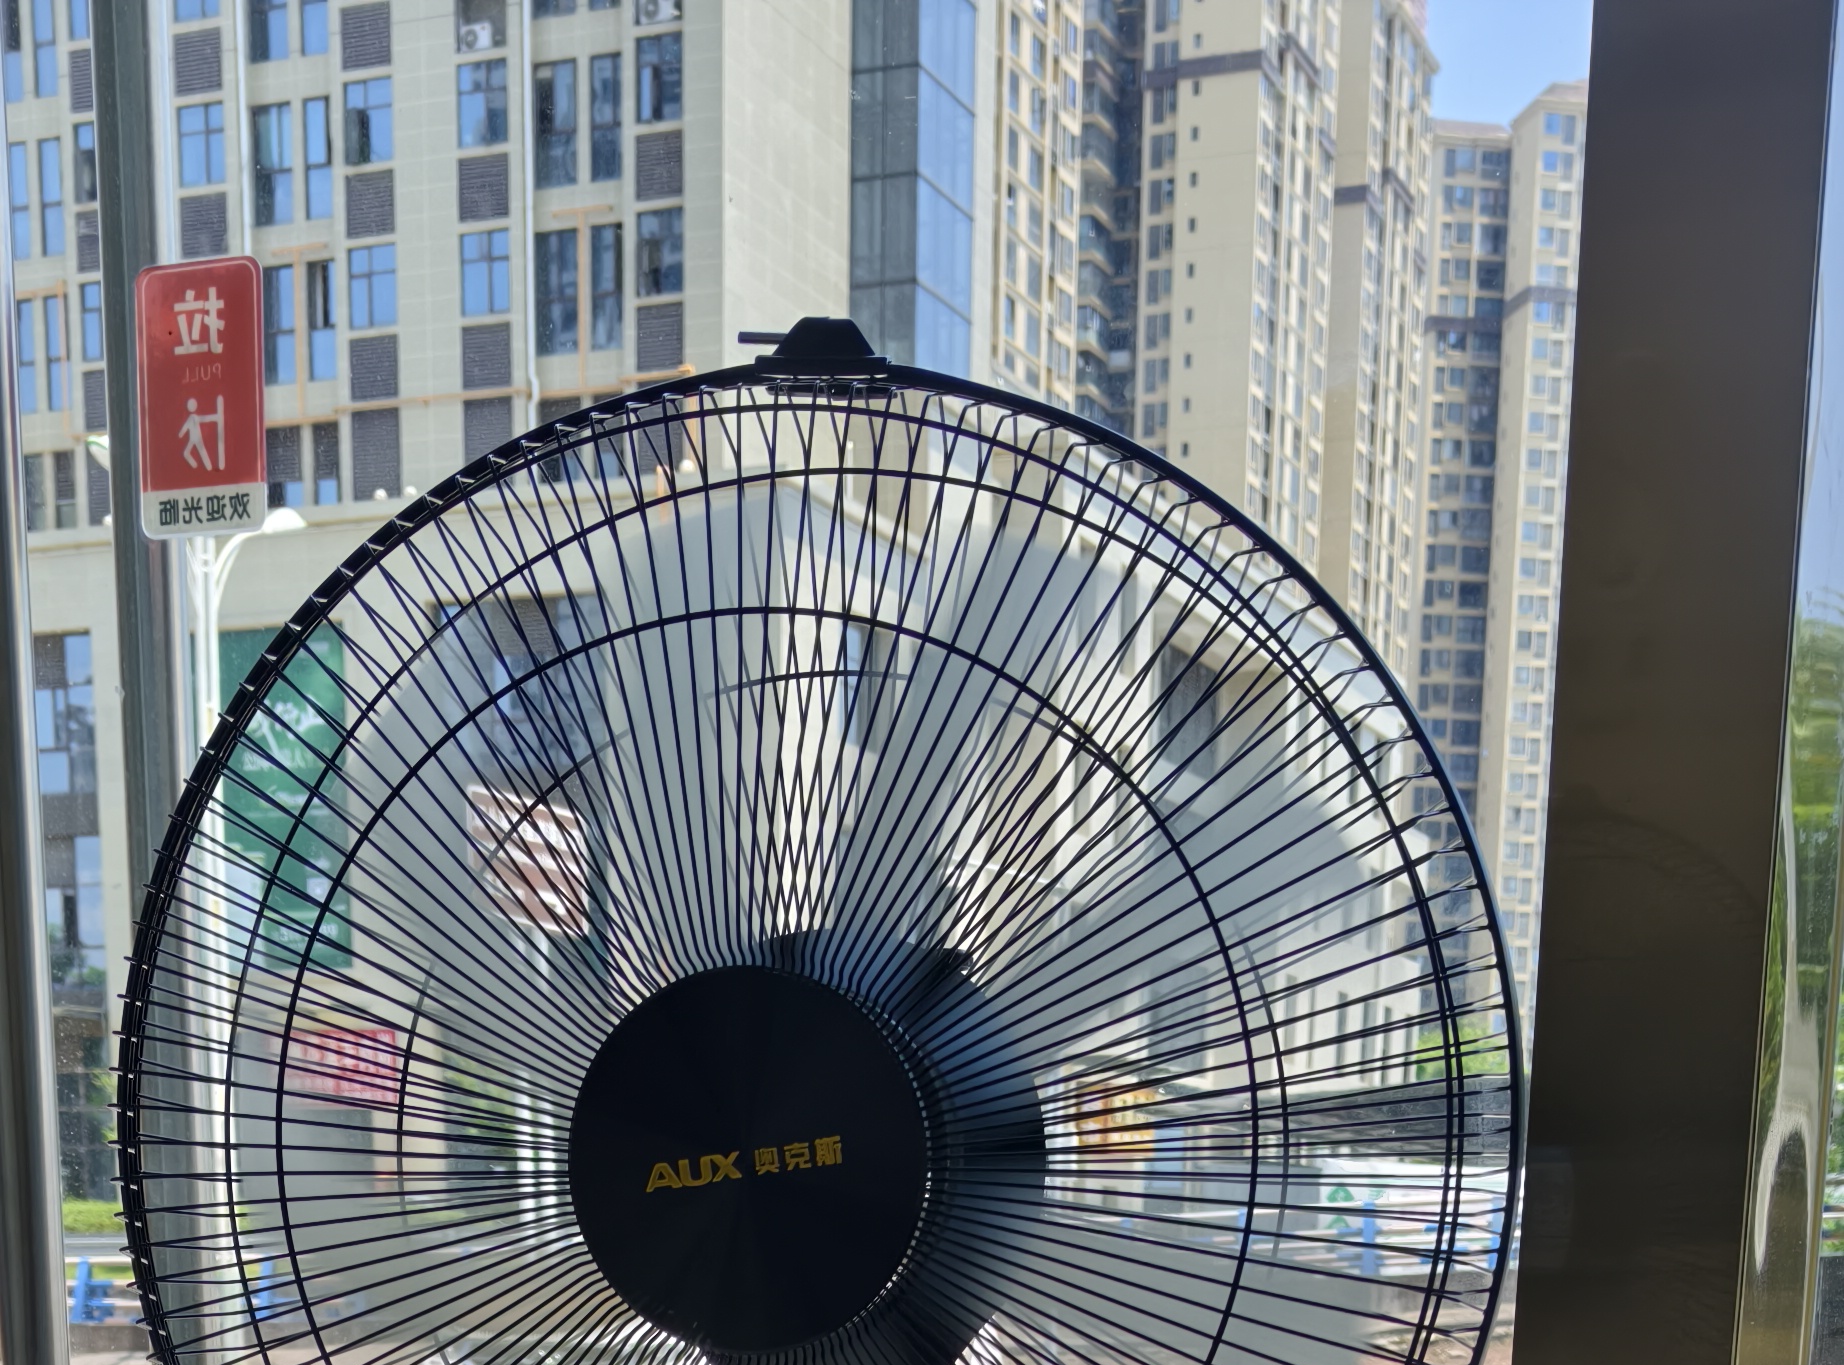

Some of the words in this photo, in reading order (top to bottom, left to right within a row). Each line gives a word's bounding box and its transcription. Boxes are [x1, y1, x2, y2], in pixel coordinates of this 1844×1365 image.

[645, 1151, 742, 1192] AUX
[754, 1135, 842, 1176] 奥克斯
